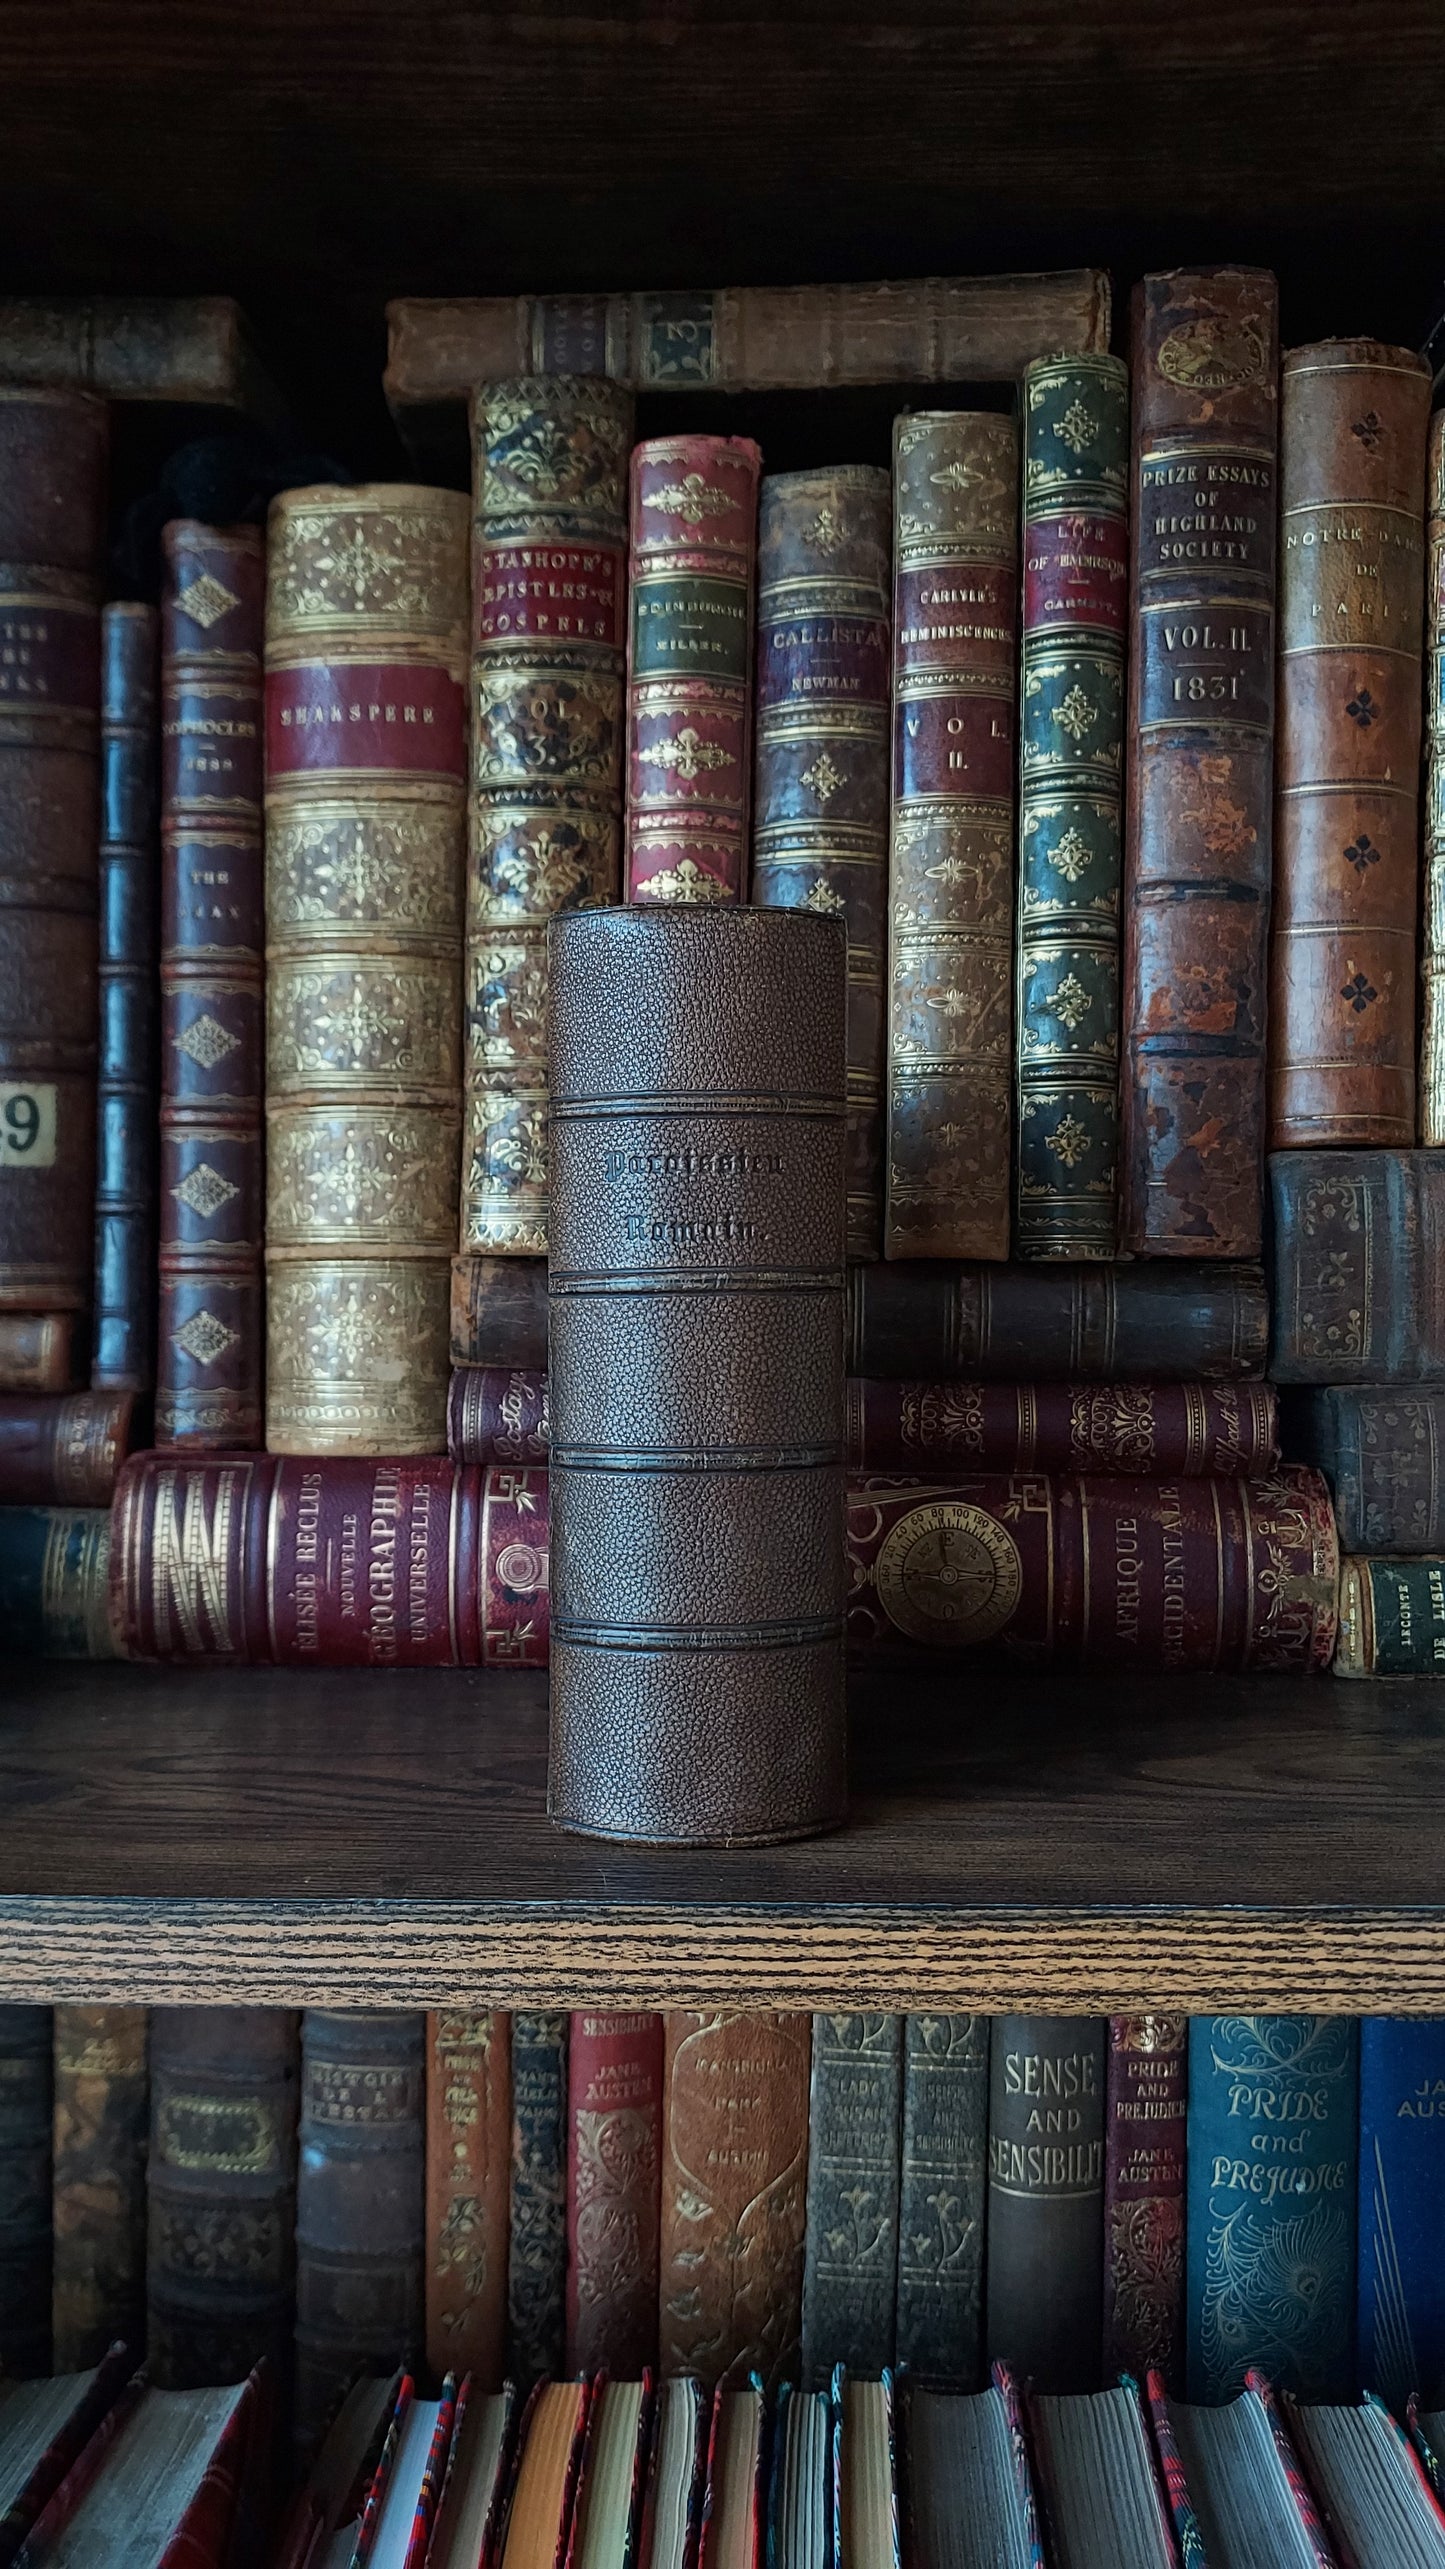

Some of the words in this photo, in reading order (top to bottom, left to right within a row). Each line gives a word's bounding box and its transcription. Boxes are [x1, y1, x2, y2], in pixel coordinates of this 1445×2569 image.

[1142, 464, 1199, 488] PRIZE
[1206, 464, 1270, 488] ESSAYS
[1194, 490, 1219, 508] OF
[1154, 514, 1257, 536] HIGHLAND
[1159, 541, 1249, 560] SOCIETY
[1027, 555, 1050, 572] OF
[1355, 564, 1377, 577] DE
[481, 612, 606, 636] GOSPELS
[772, 627, 880, 650] CALLISTA
[791, 676, 860, 692] NEWMAN
[1172, 675, 1240, 701] 1831
[280, 703, 437, 727] SHAKSPERE
[0, 1094, 39, 1152] 9
[603, 1150, 788, 1182] Paroissien
[294, 1473, 323, 1563] RECLUS
[910, 1512, 925, 1527] 60
[930, 1507, 945, 1518] 80
[951, 1507, 970, 1519] 100
[973, 1513, 990, 1529] 120
[895, 1525, 908, 1540] 40
[990, 1526, 1005, 1544] 140
[339, 1513, 359, 1618] NOUVELLE
[361, 1467, 402, 1661] GÉOGRAPHIE
[408, 1483, 432, 1644] UNIVERSELLE
[1002, 1546, 1015, 1565] 160
[1008, 1568, 1017, 1587] 180
[1115, 1517, 1144, 1644] AFRIQUE
[1428, 1570, 1445, 1621] LISLE
[287, 1572, 319, 1651] ÉLISÉE
[1397, 1584, 1412, 1647] LECONTE
[595, 2062, 641, 2081] JANE
[1003, 2050, 1097, 2100] SENSE
[1127, 2060, 1180, 2078] PRIDE
[584, 2075, 654, 2101] AUSTEN
[840, 2079, 880, 2097] LADY
[1136, 2082, 1170, 2098] AND
[1116, 2099, 1186, 2121] PREJUDICE
[1226, 2083, 1329, 2122] PRIDE
[1025, 2106, 1081, 2134] AND
[1250, 2127, 1312, 2154] and
[1127, 2146, 1175, 2165] JANE
[1117, 2163, 1184, 2185] AUSTEN
[1209, 2154, 1347, 2207] PREJUDICE
